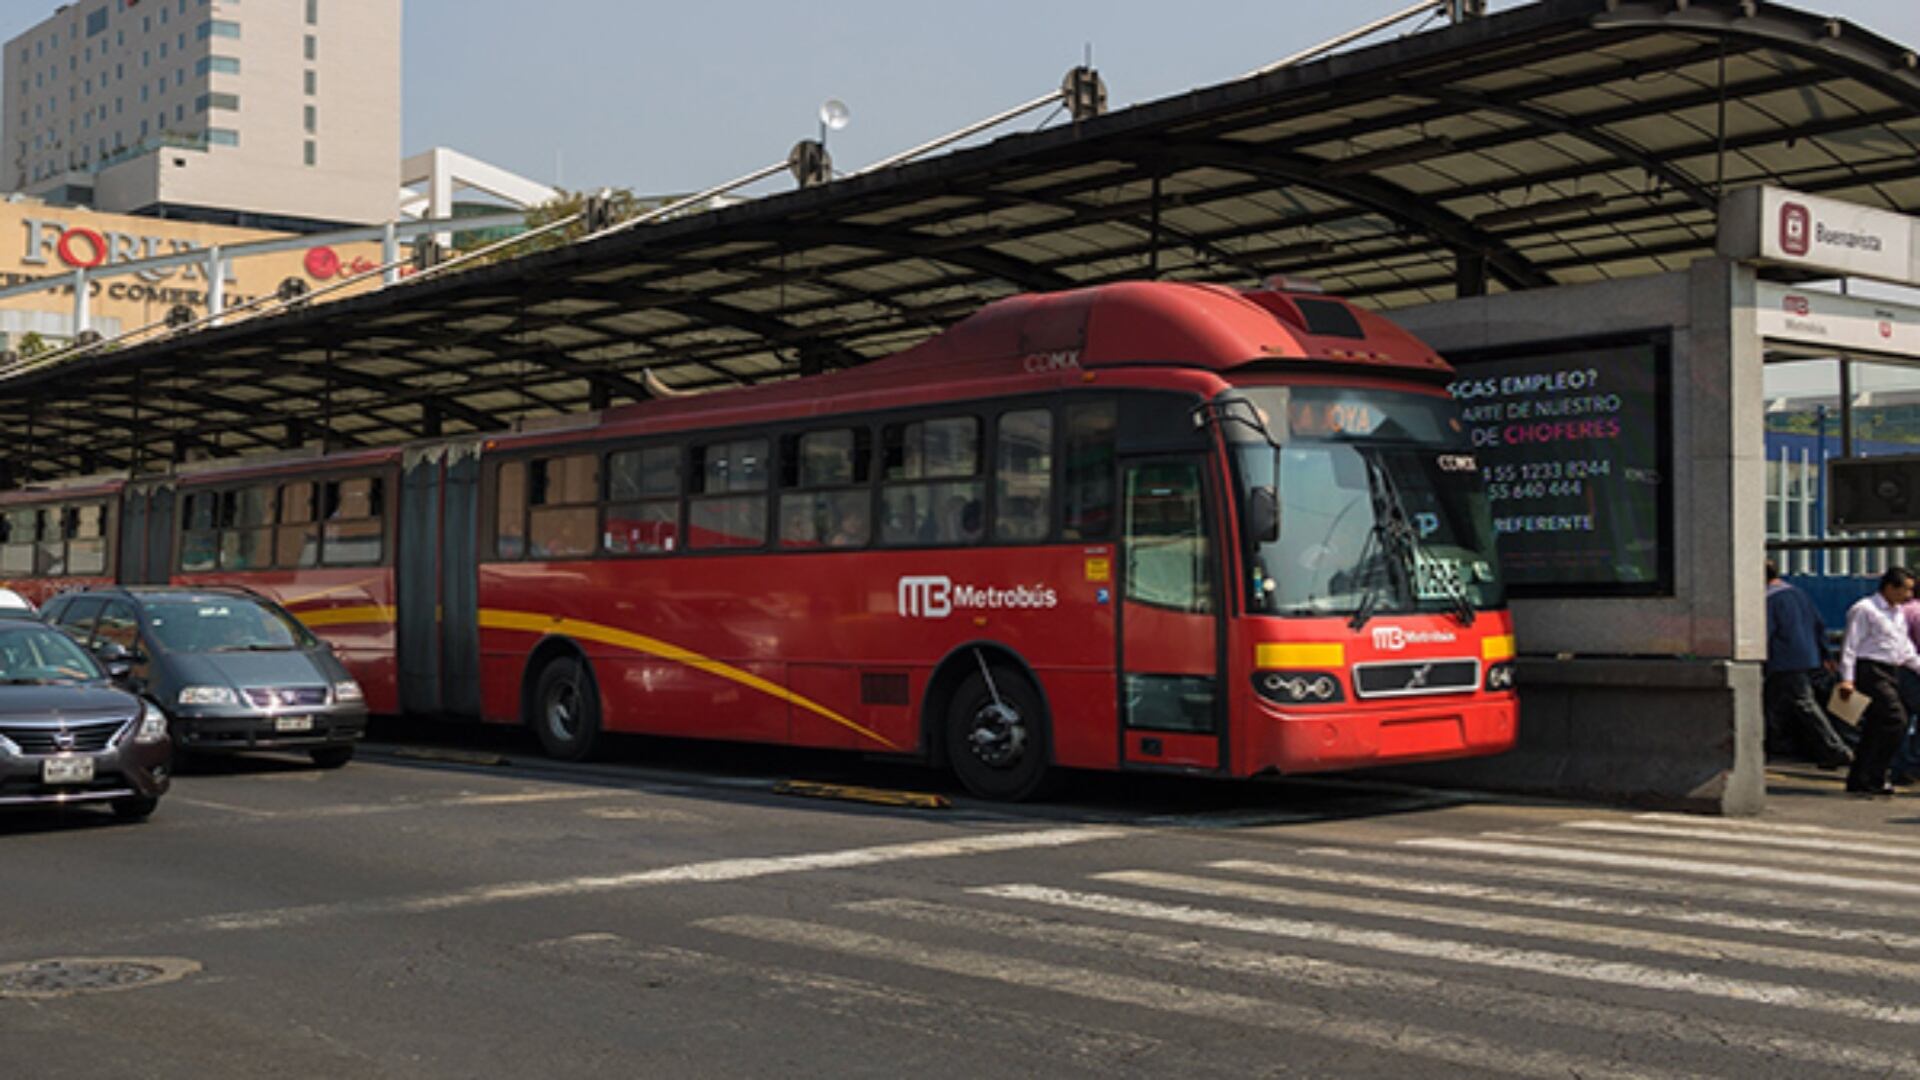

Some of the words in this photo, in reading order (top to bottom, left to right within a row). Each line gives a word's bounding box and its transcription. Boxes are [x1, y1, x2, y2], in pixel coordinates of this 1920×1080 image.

[1501, 369, 1597, 394] EMPLEO?
[1506, 401, 1531, 419] DE
[1536, 394, 1621, 416] NUESTRO
[1471, 426, 1500, 447] DE
[1504, 417, 1620, 444] CHOFERES
[953, 582, 1057, 608] Metrobús
